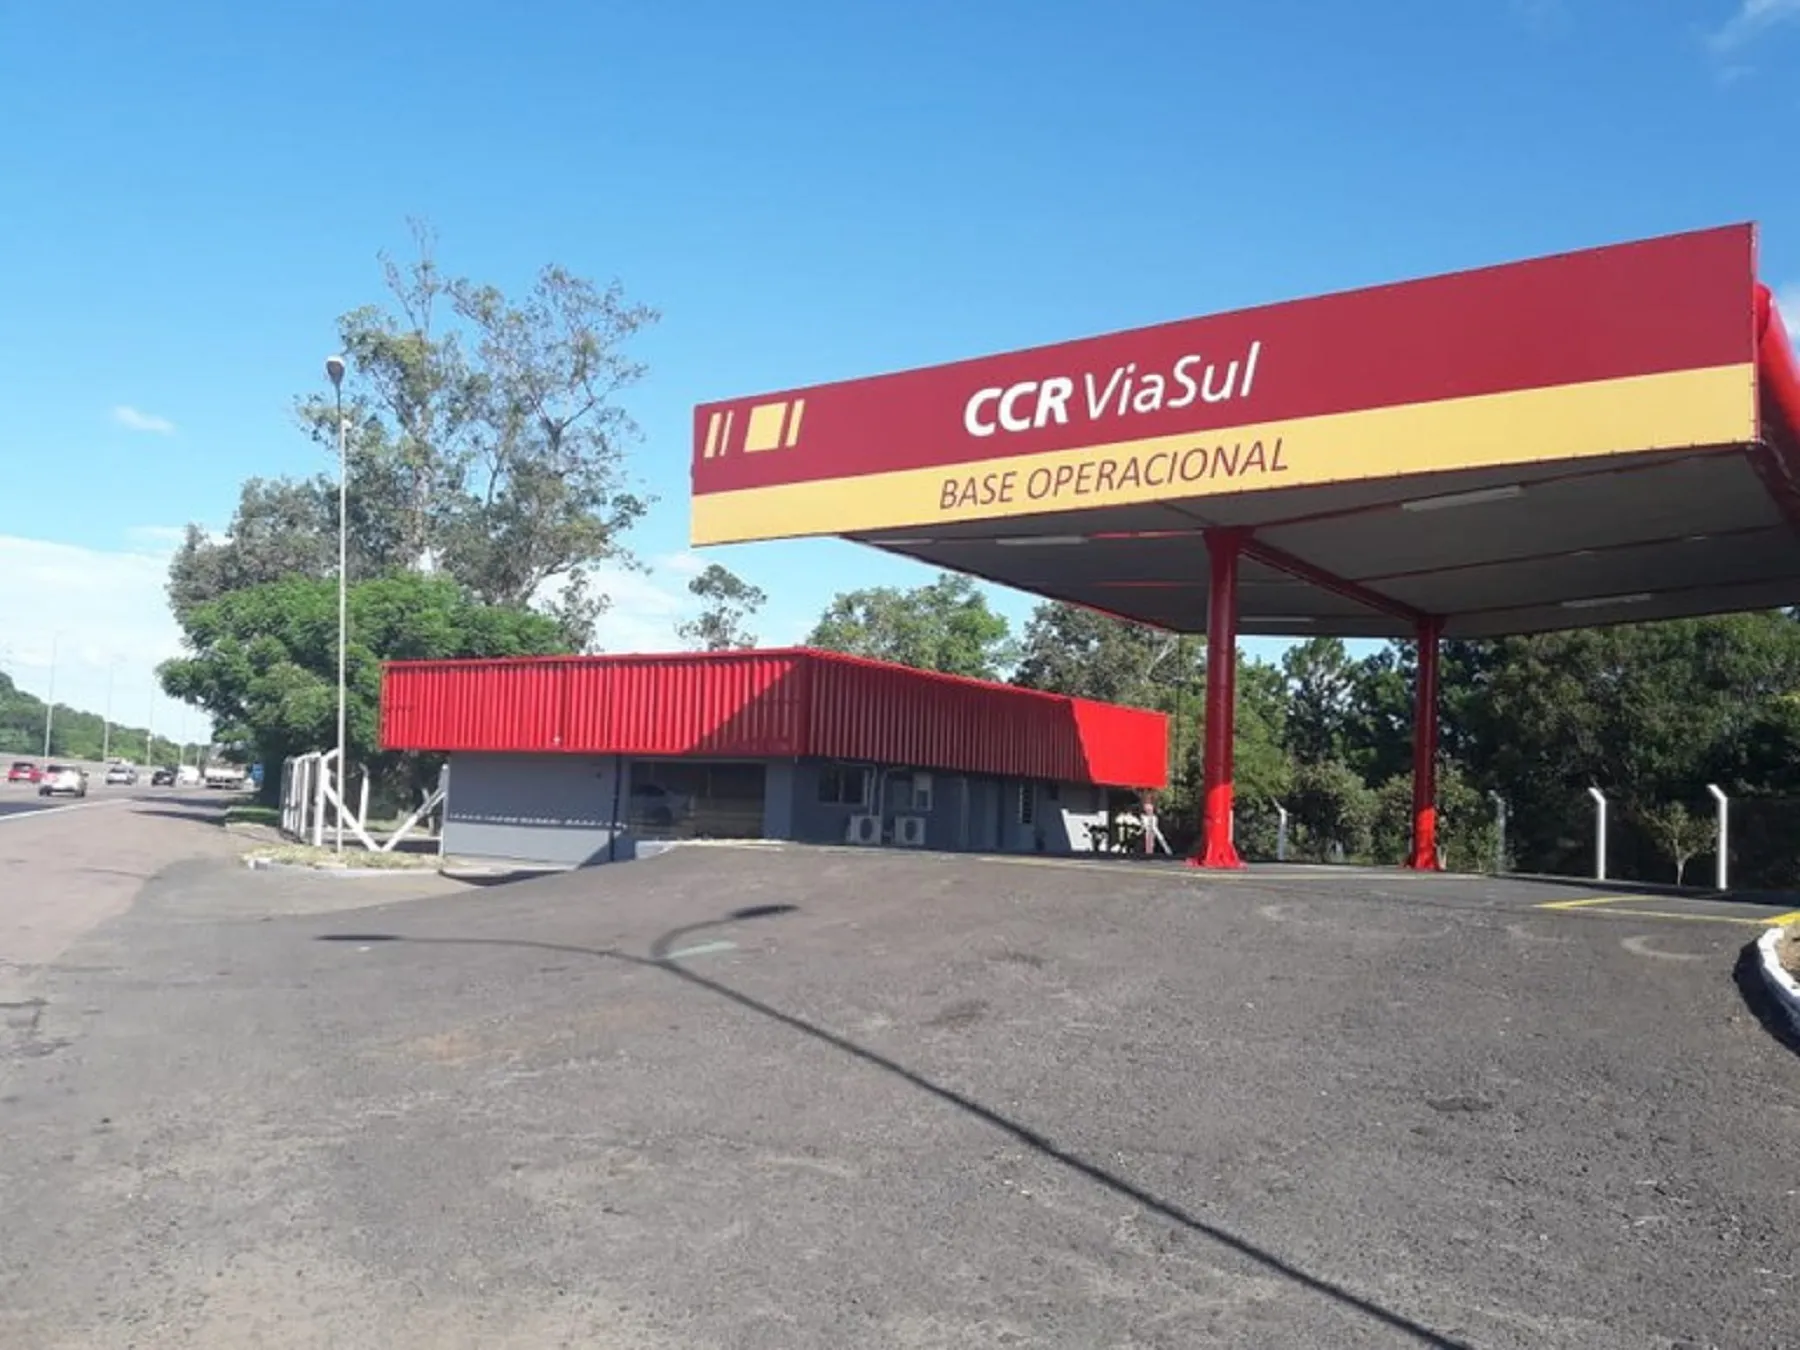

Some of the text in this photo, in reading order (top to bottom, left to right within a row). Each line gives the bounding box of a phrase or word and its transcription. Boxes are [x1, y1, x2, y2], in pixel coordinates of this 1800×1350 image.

[963, 341, 1260, 437] CCR ViaSul
[939, 437, 1288, 510] BASE OPERACIONAL
